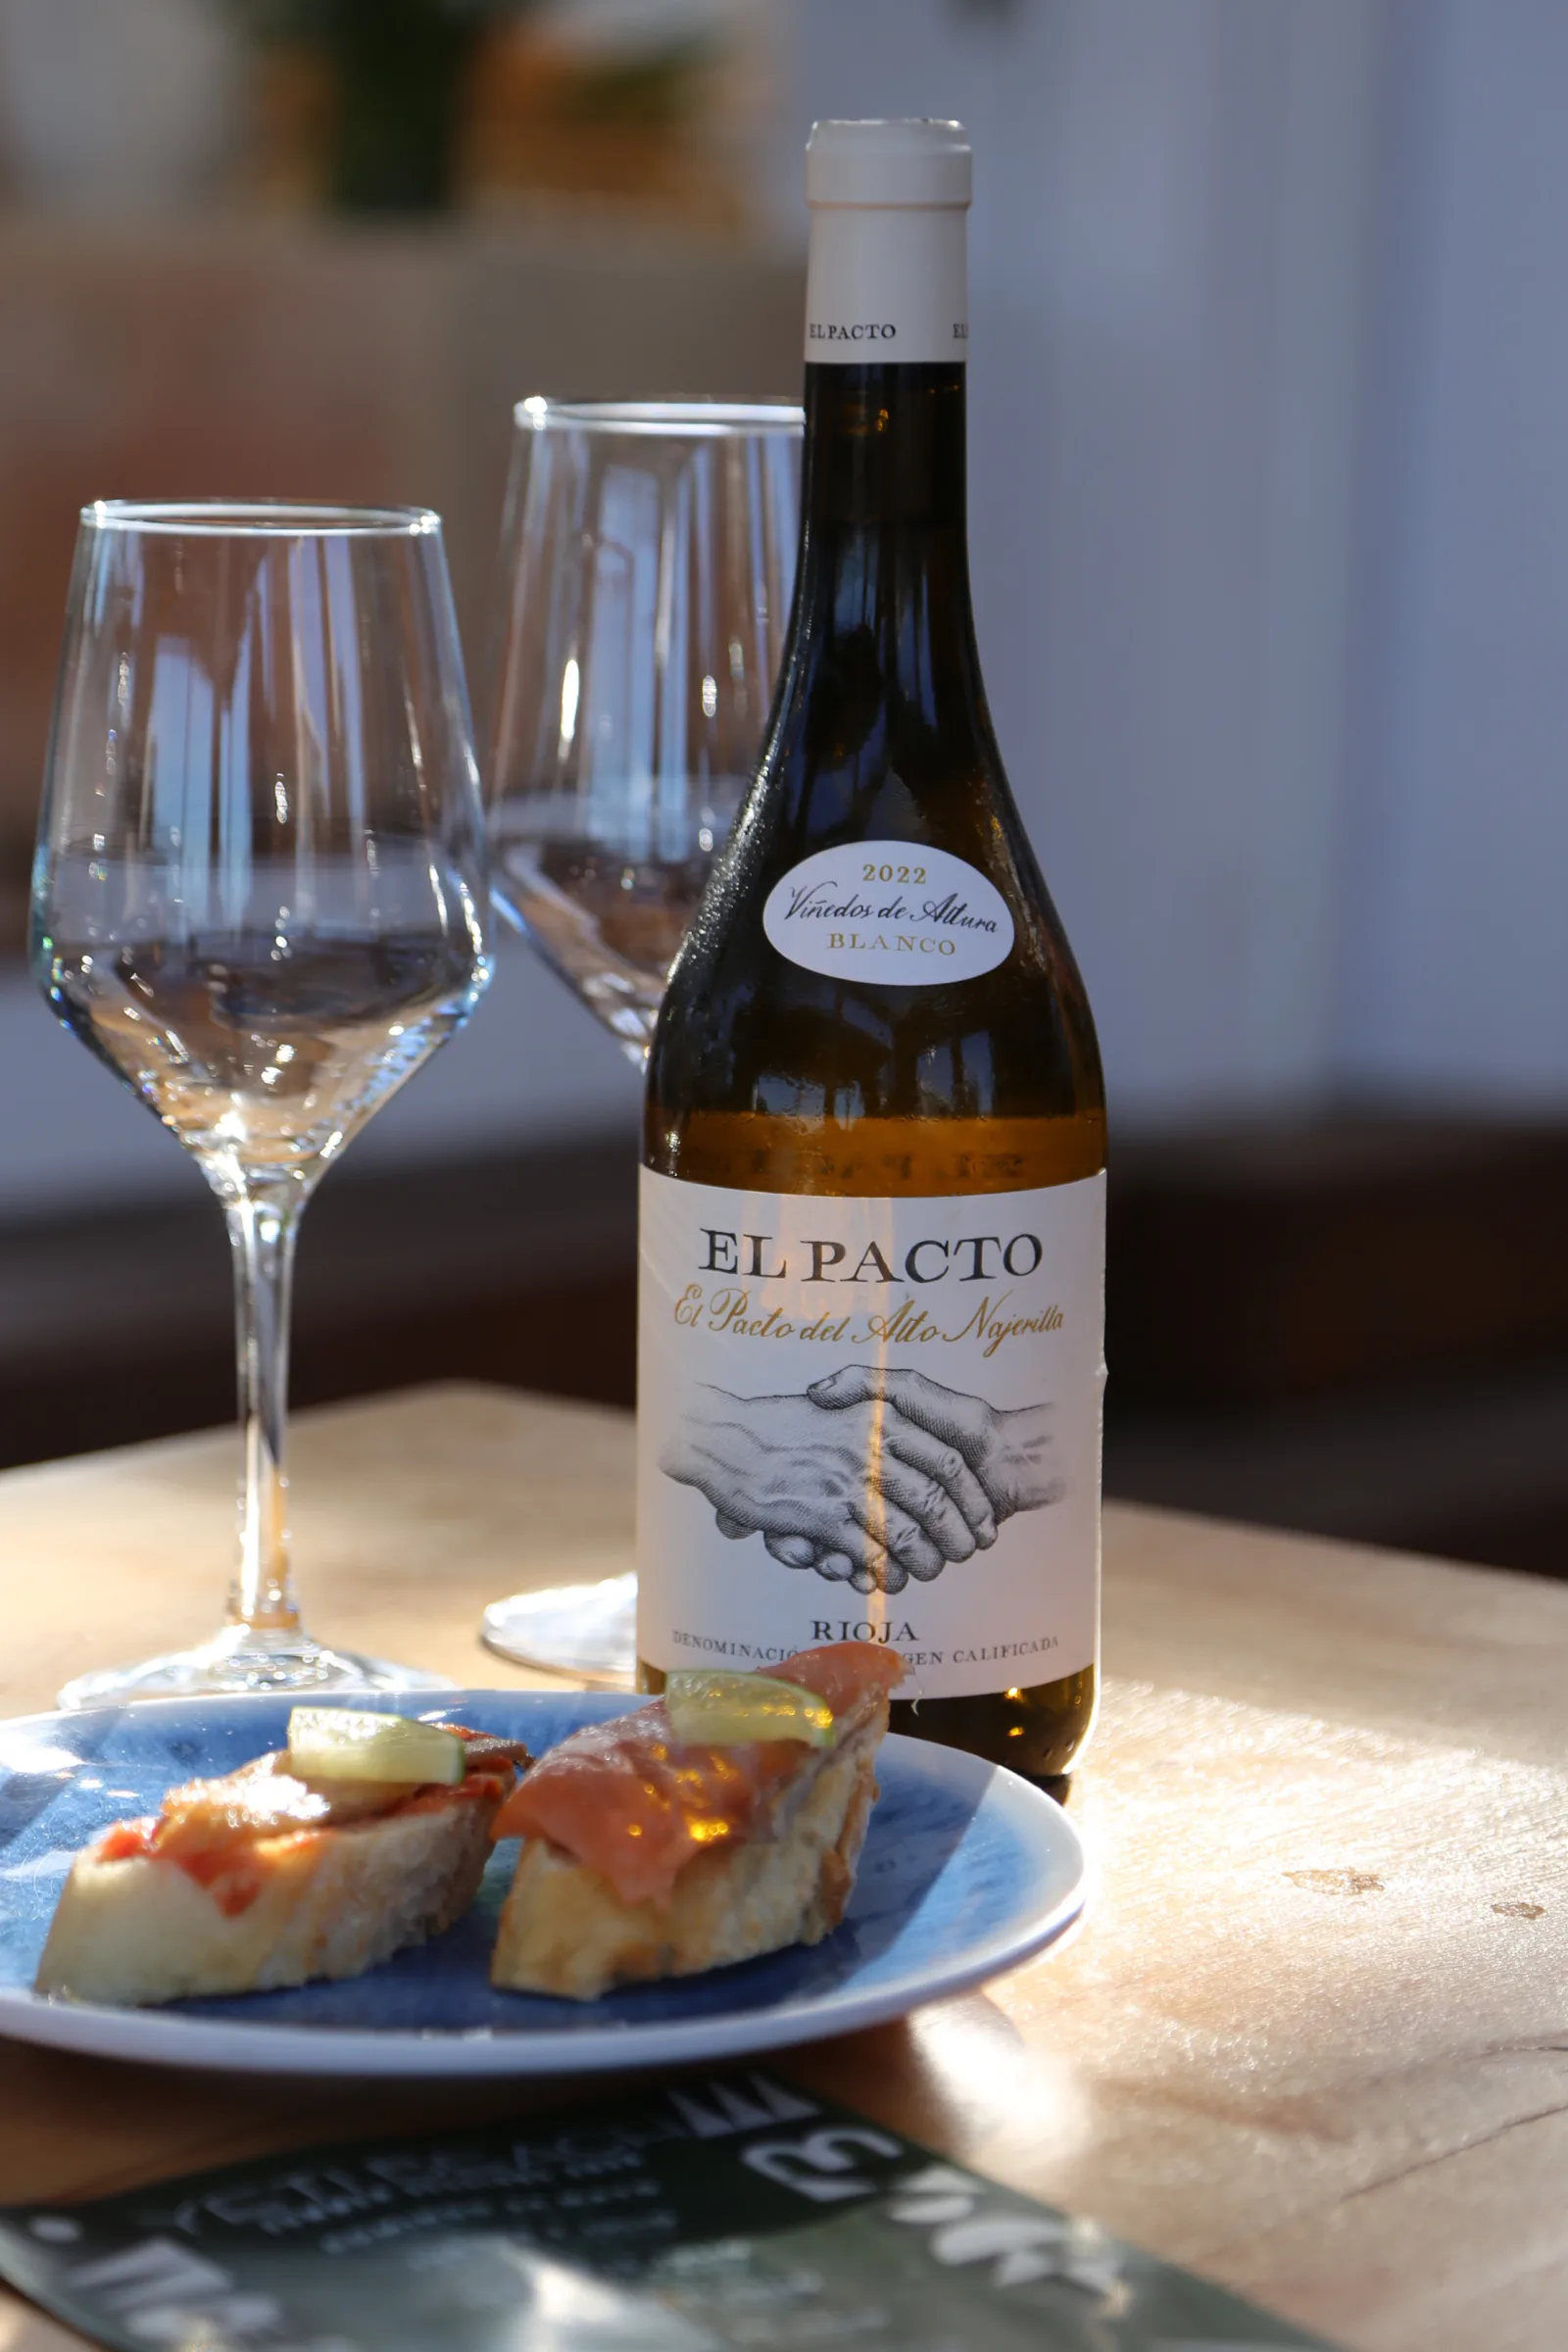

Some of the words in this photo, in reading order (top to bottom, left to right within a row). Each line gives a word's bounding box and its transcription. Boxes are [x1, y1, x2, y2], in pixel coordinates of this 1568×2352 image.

[827, 323, 896, 340] PACTO
[862, 863, 927, 884] 2022
[784, 881, 873, 921] Viñedos
[878, 896, 908, 920] de
[910, 893, 998, 933] Altura
[827, 933, 956, 956] BLANCO
[698, 1227, 787, 1279] EL
[800, 1233, 1043, 1284] PACTO
[674, 1284, 703, 1327] El
[708, 1288, 796, 1339] Pacto
[799, 1316, 850, 1343] del
[852, 1297, 943, 1344] Alto
[943, 1290, 1065, 1357] Najerilla
[810, 1620, 920, 1643] RIOJA
[671, 1630, 799, 1662] DENOMINACIÓ
[953, 1635, 1059, 1664] CALIFICADA
